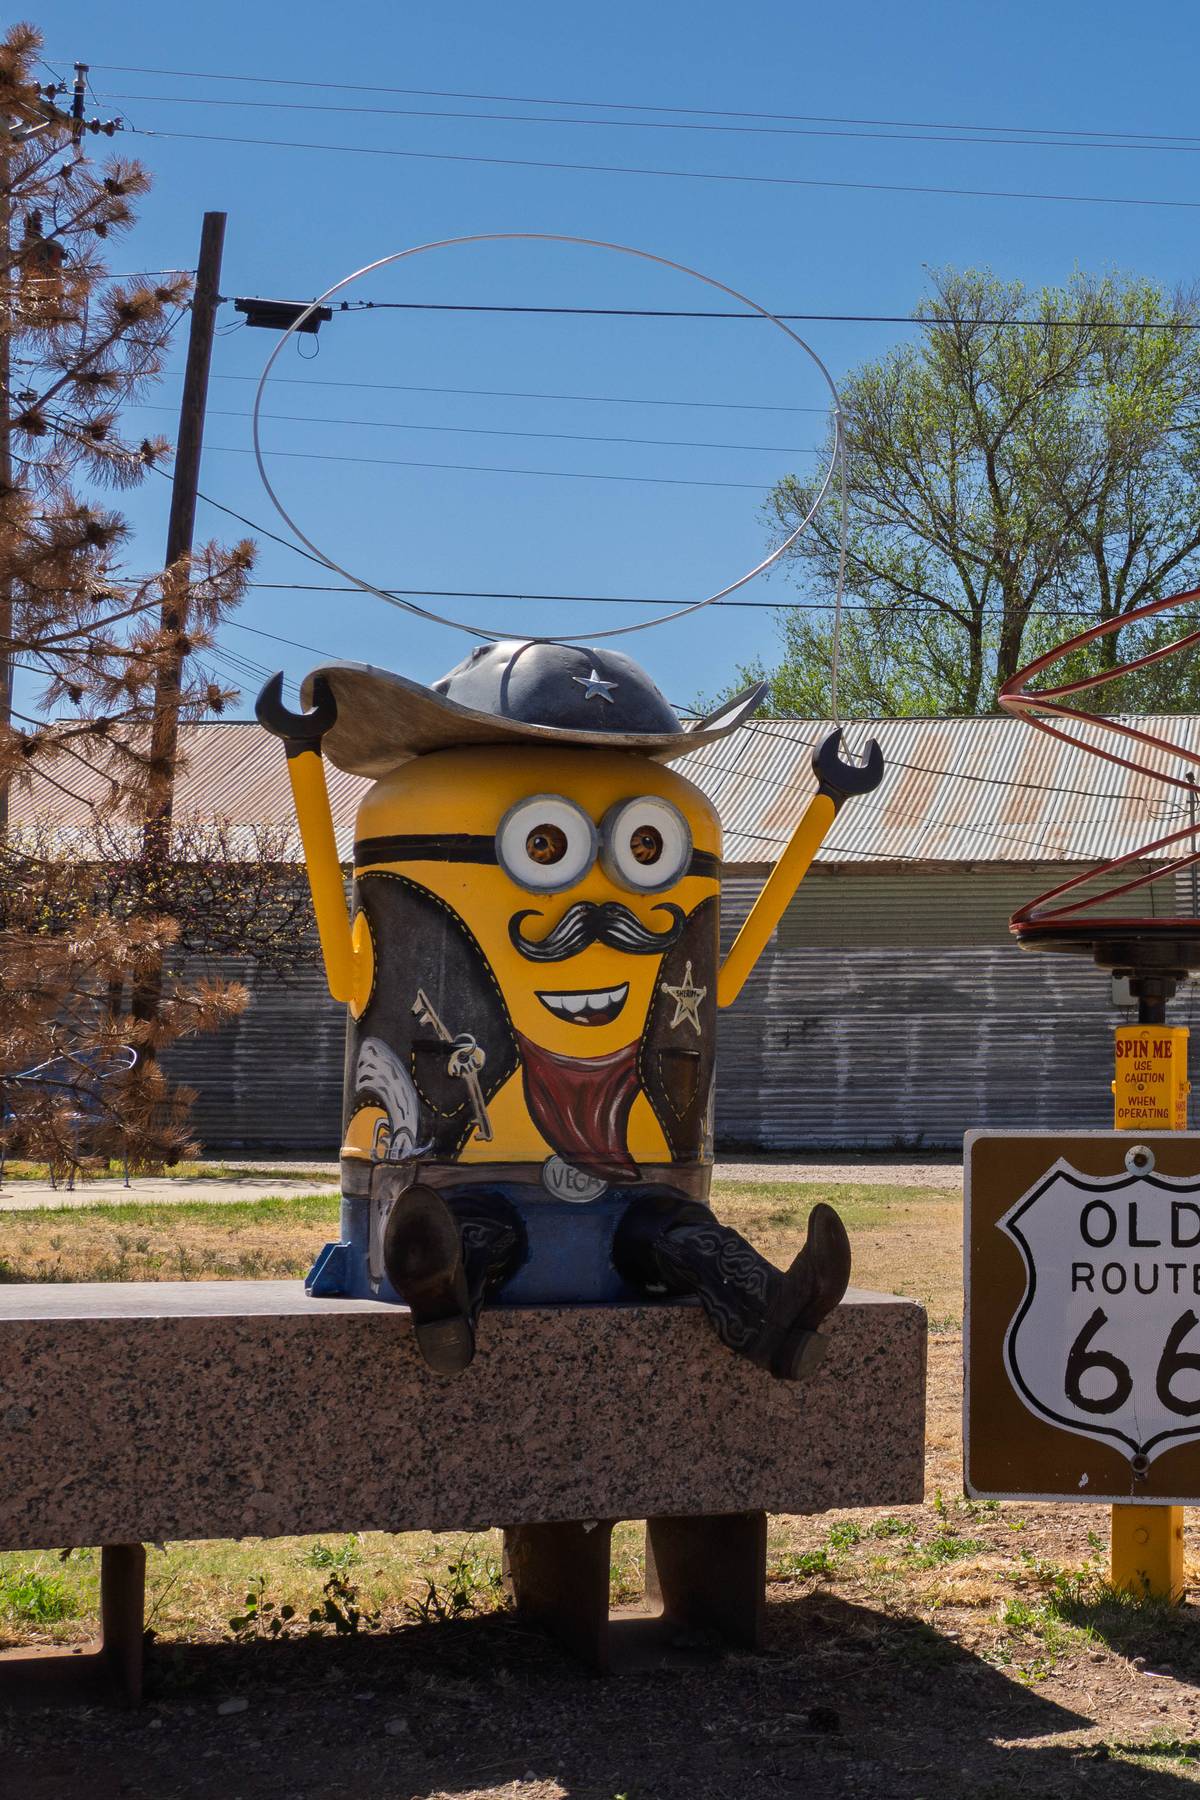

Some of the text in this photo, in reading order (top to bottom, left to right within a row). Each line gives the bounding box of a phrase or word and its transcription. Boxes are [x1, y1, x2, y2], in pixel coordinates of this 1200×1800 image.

[1116, 1040, 1172, 1058] SPIN ME
[1134, 1061, 1152, 1071] USE
[1125, 1072, 1165, 1083] CAUTION
[1128, 1096, 1156, 1106] WHEN
[1118, 1108, 1169, 1119] OPERATING
